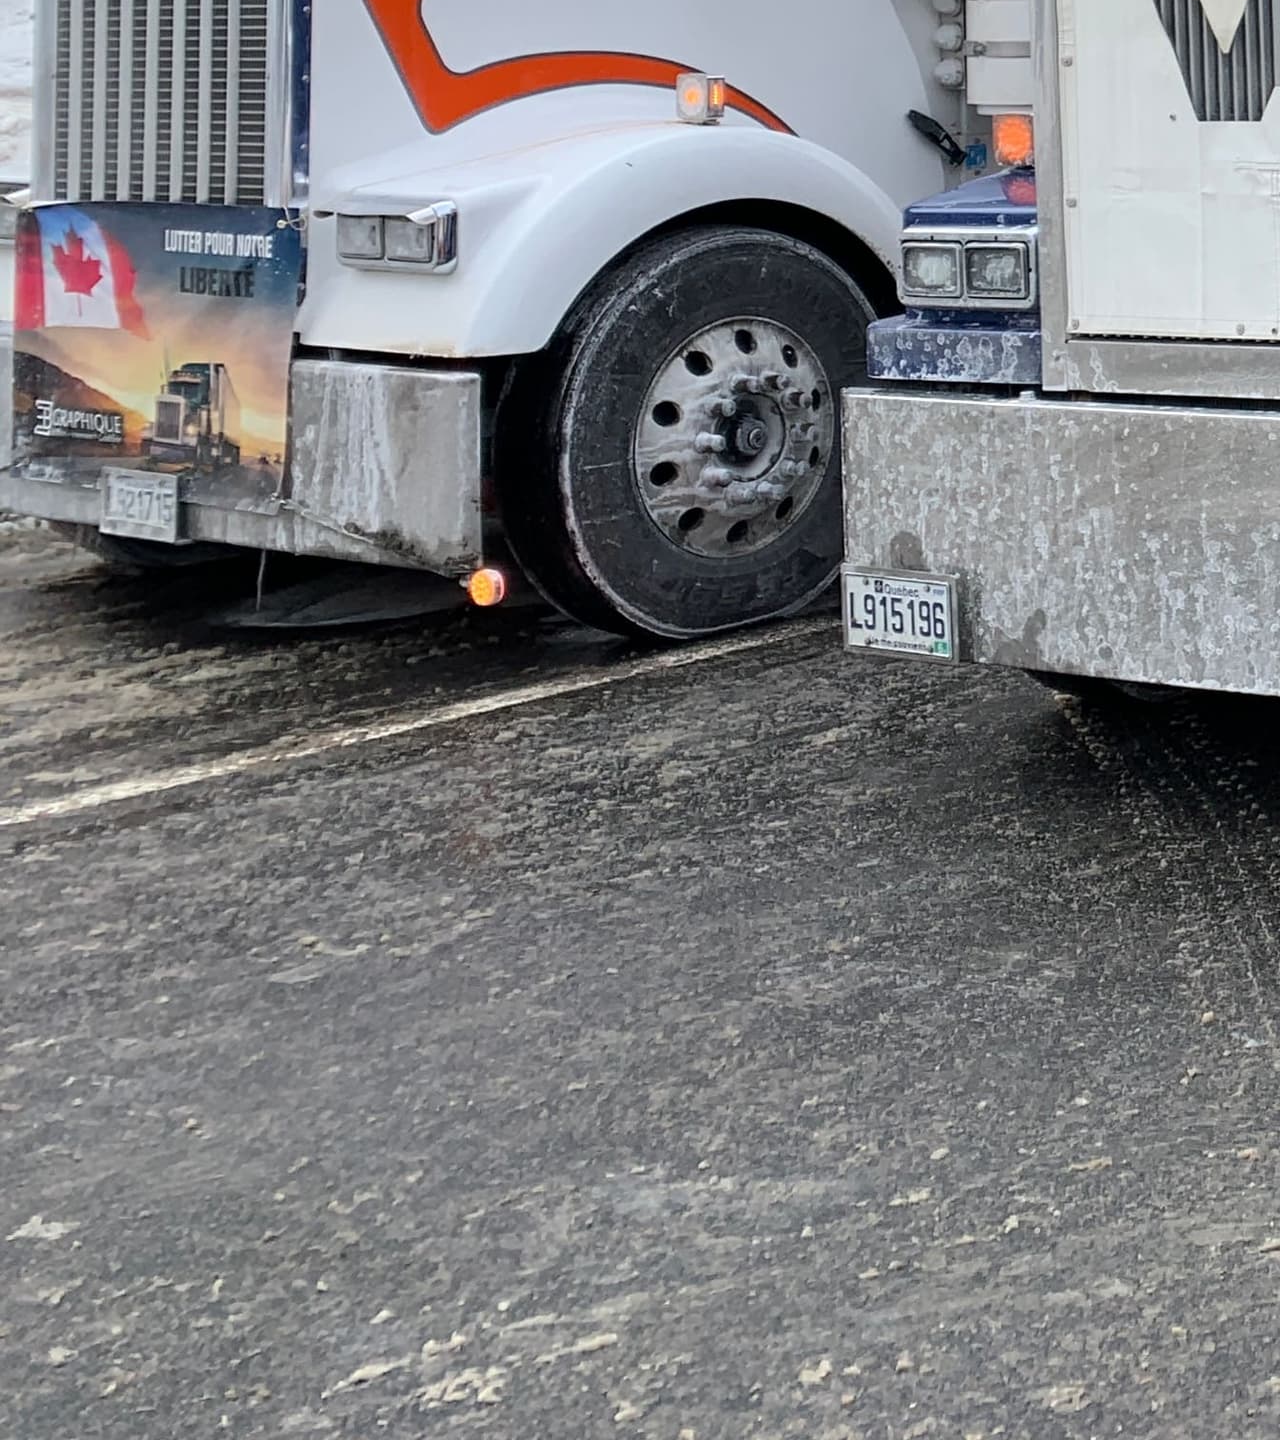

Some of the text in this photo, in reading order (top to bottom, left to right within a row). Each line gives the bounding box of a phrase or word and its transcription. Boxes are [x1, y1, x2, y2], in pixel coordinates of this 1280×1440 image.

[164, 229, 273, 258] LUTTER POUR NOTRE
[180, 263, 255, 298] LIBERTÉ
[53, 408, 122, 434] GRAPHIQUE
[849, 591, 945, 639] L915196
